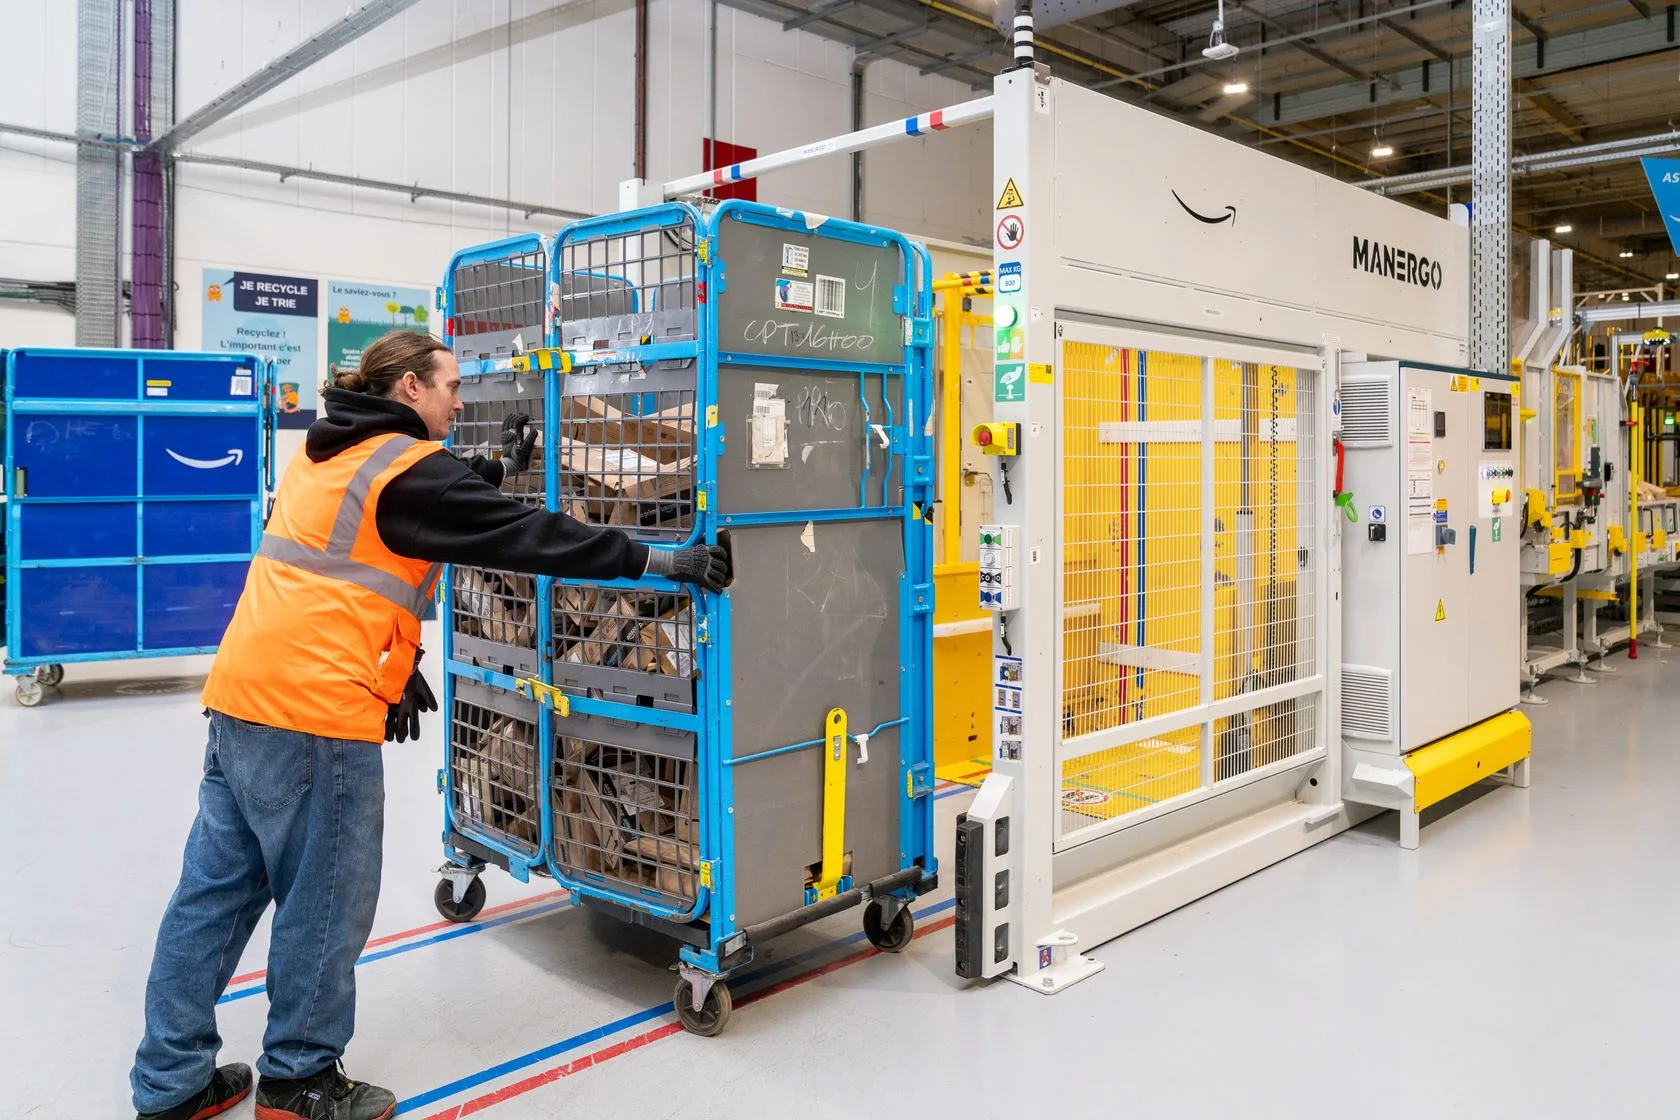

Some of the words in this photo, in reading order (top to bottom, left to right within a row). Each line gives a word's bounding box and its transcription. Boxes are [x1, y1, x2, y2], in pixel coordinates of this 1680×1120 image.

[1353, 235, 1442, 291] MANERGO
[1000, 267, 1013, 275] MAX
[240, 280, 254, 291] JE
[256, 281, 308, 296] RECYCLE
[332, 286, 343, 294] Le
[344, 287, 391, 298] saviez-vous
[255, 296, 269, 307] JE
[271, 297, 297, 309] TRIE
[236, 327, 280, 339] Recyclez
[220, 340, 277, 352] L'important
[278, 343, 302, 353] c'est
